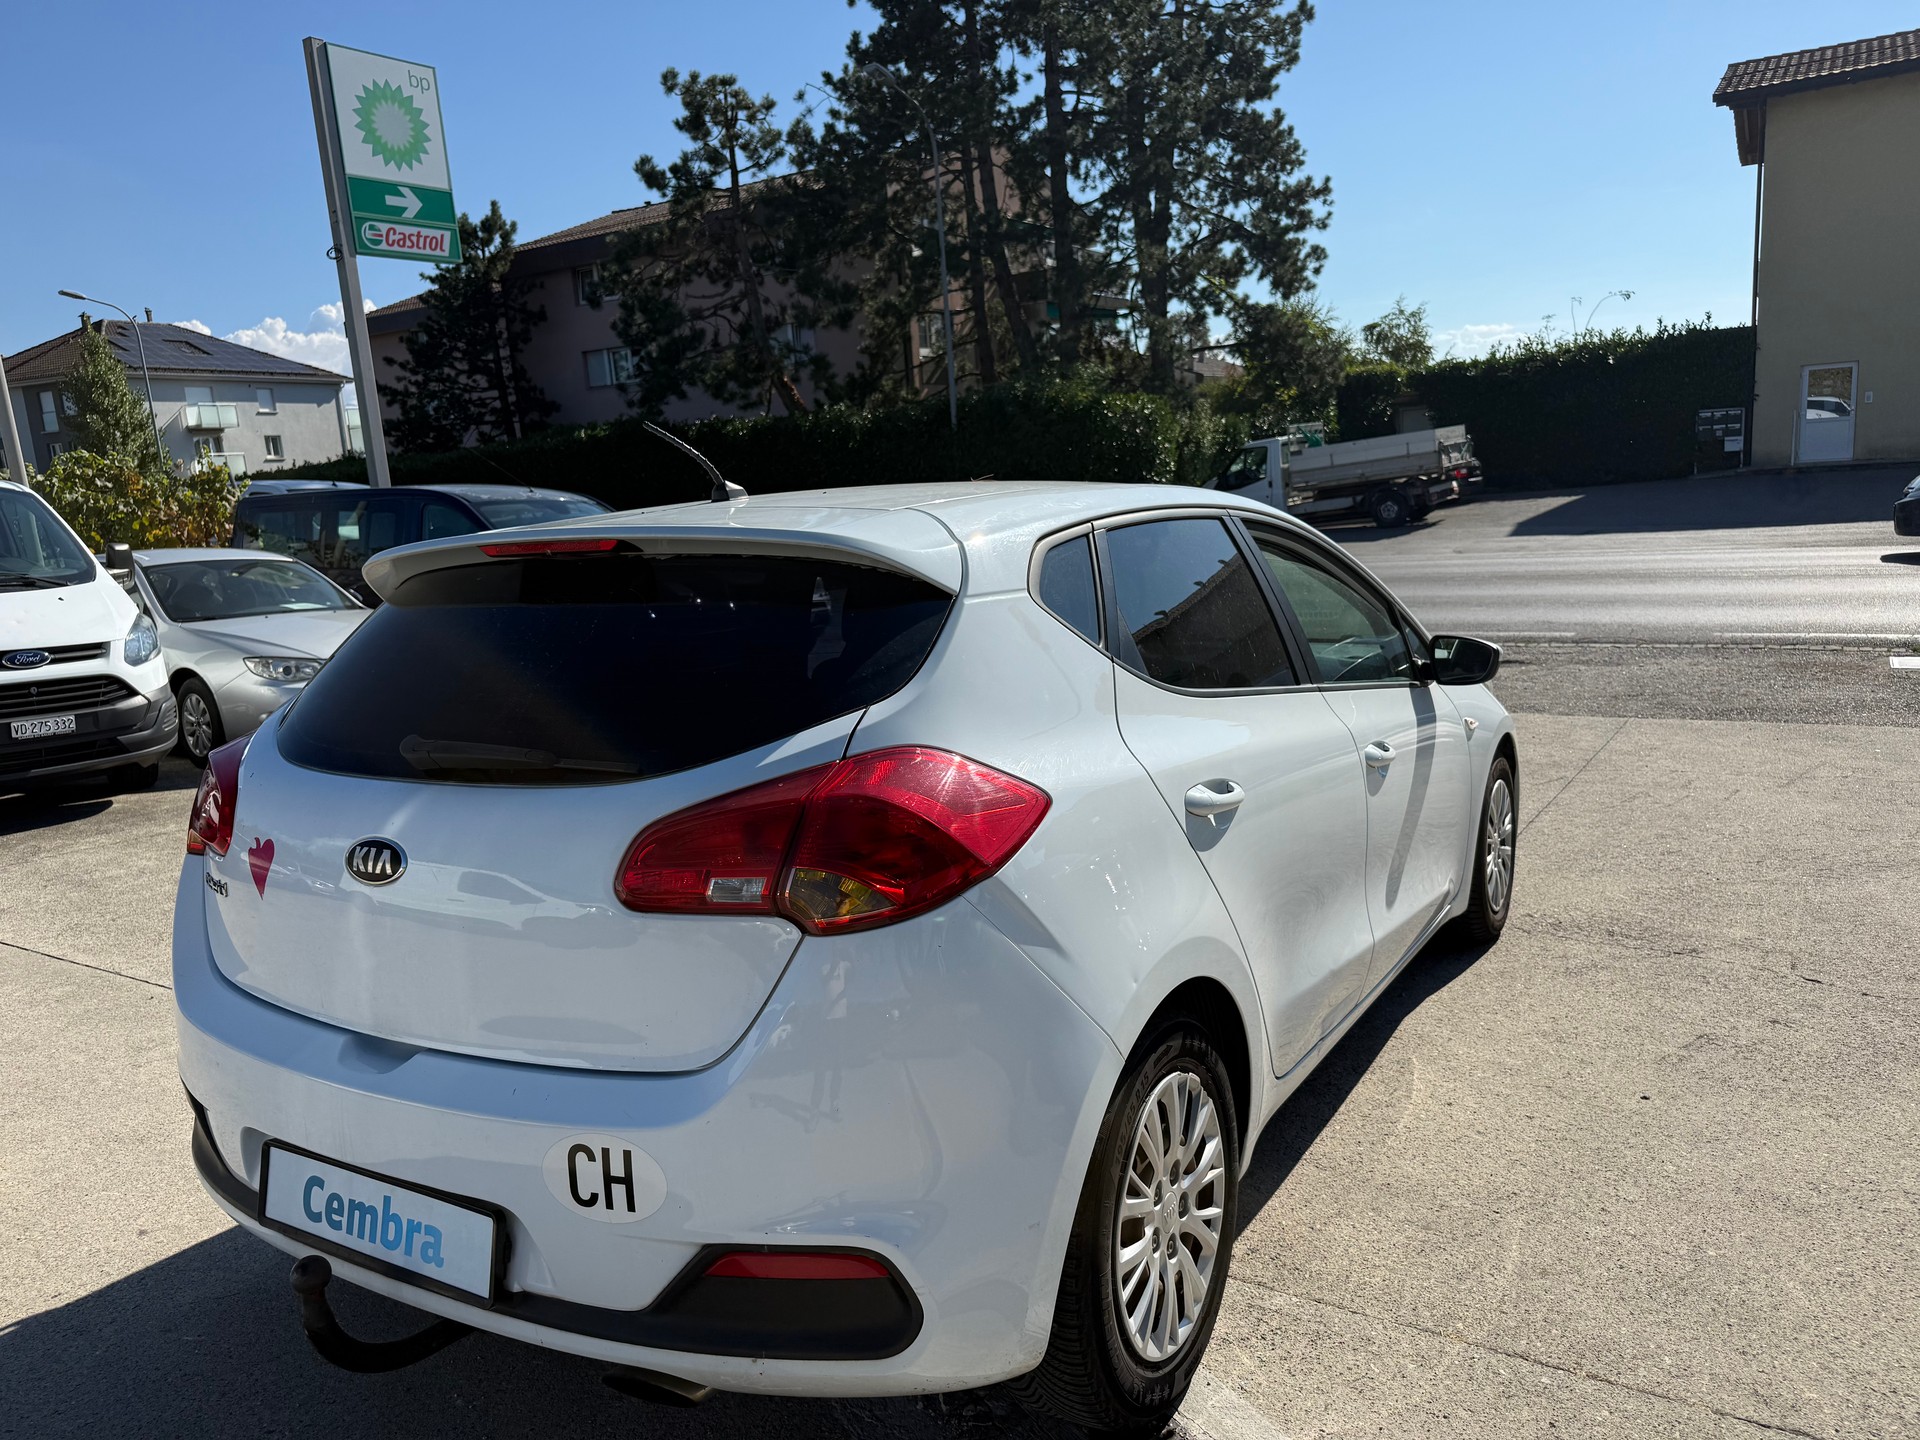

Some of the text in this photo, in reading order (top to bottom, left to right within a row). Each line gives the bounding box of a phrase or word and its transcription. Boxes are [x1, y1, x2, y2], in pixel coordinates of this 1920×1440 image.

[408, 69, 431, 94] bp
[384, 226, 446, 253] Castrol
[14, 652, 41, 665] Ford
[352, 845, 393, 876] KIA
[566, 1143, 637, 1213] CH
[302, 1174, 445, 1269] Cembra
